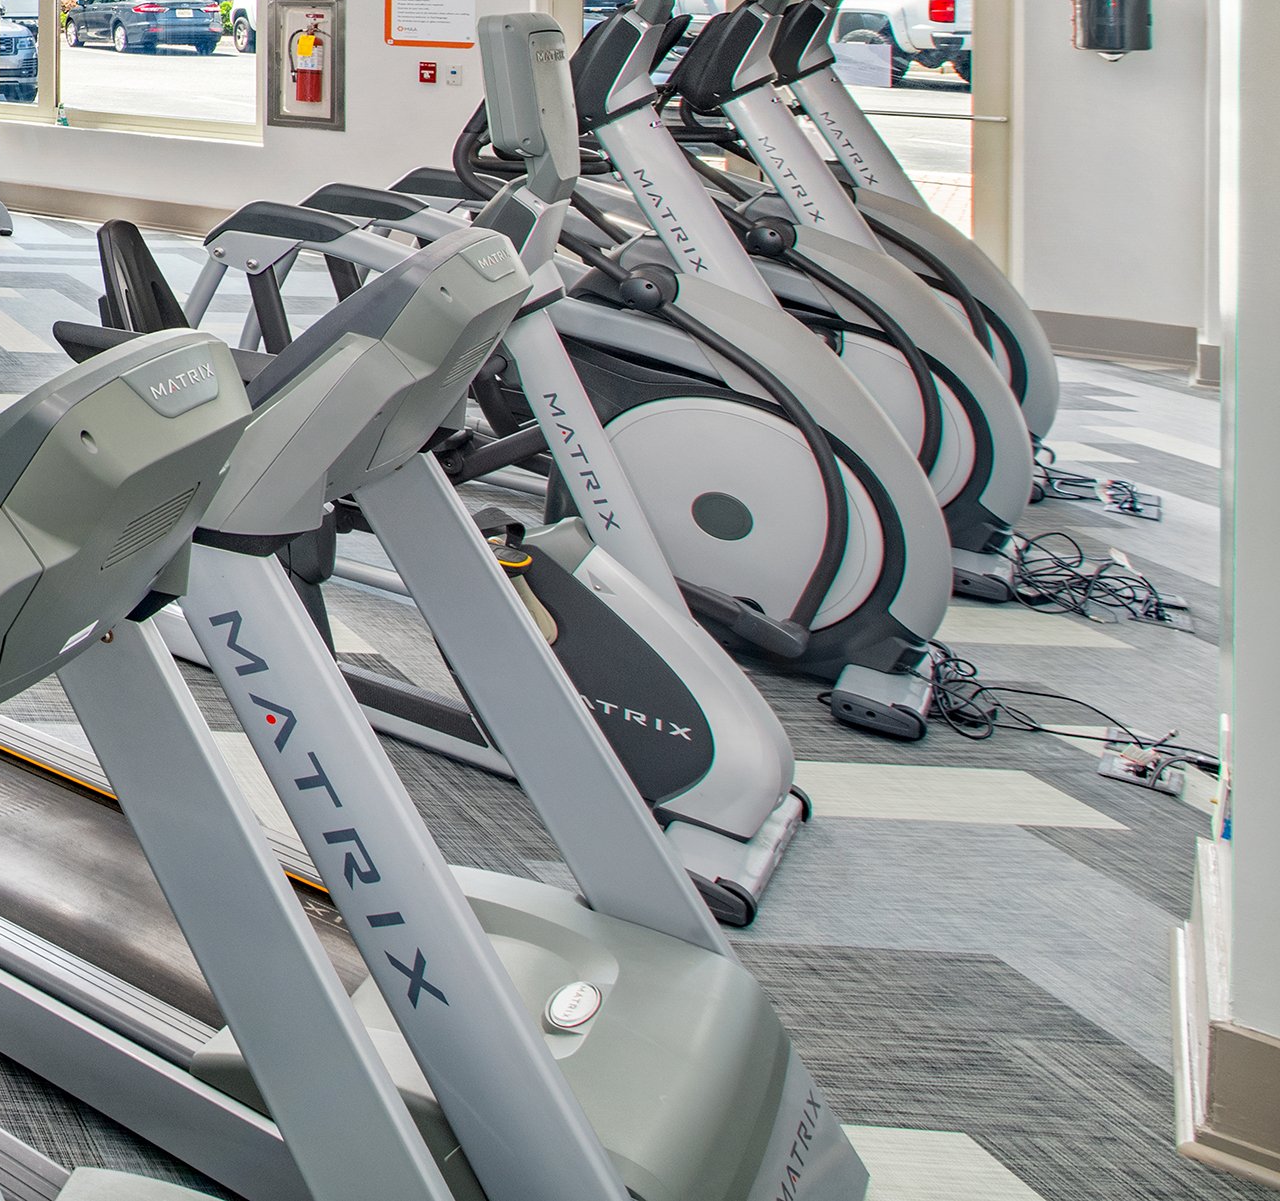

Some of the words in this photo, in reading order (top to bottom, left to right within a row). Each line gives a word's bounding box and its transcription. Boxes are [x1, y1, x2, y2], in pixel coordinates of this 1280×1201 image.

[535, 49, 565, 62] MATRI
[819, 111, 879, 186] MATRIX
[757, 136, 825, 224] MATRIX
[633, 169, 708, 273] MATRIX
[477, 249, 512, 269] MATRI
[149, 362, 215, 400] MATRIX
[542, 392, 621, 531] MATRIX
[580, 694, 692, 741] ATRIX
[208, 610, 450, 1009] MATRIX
[562, 985, 587, 1018] MATRIX
